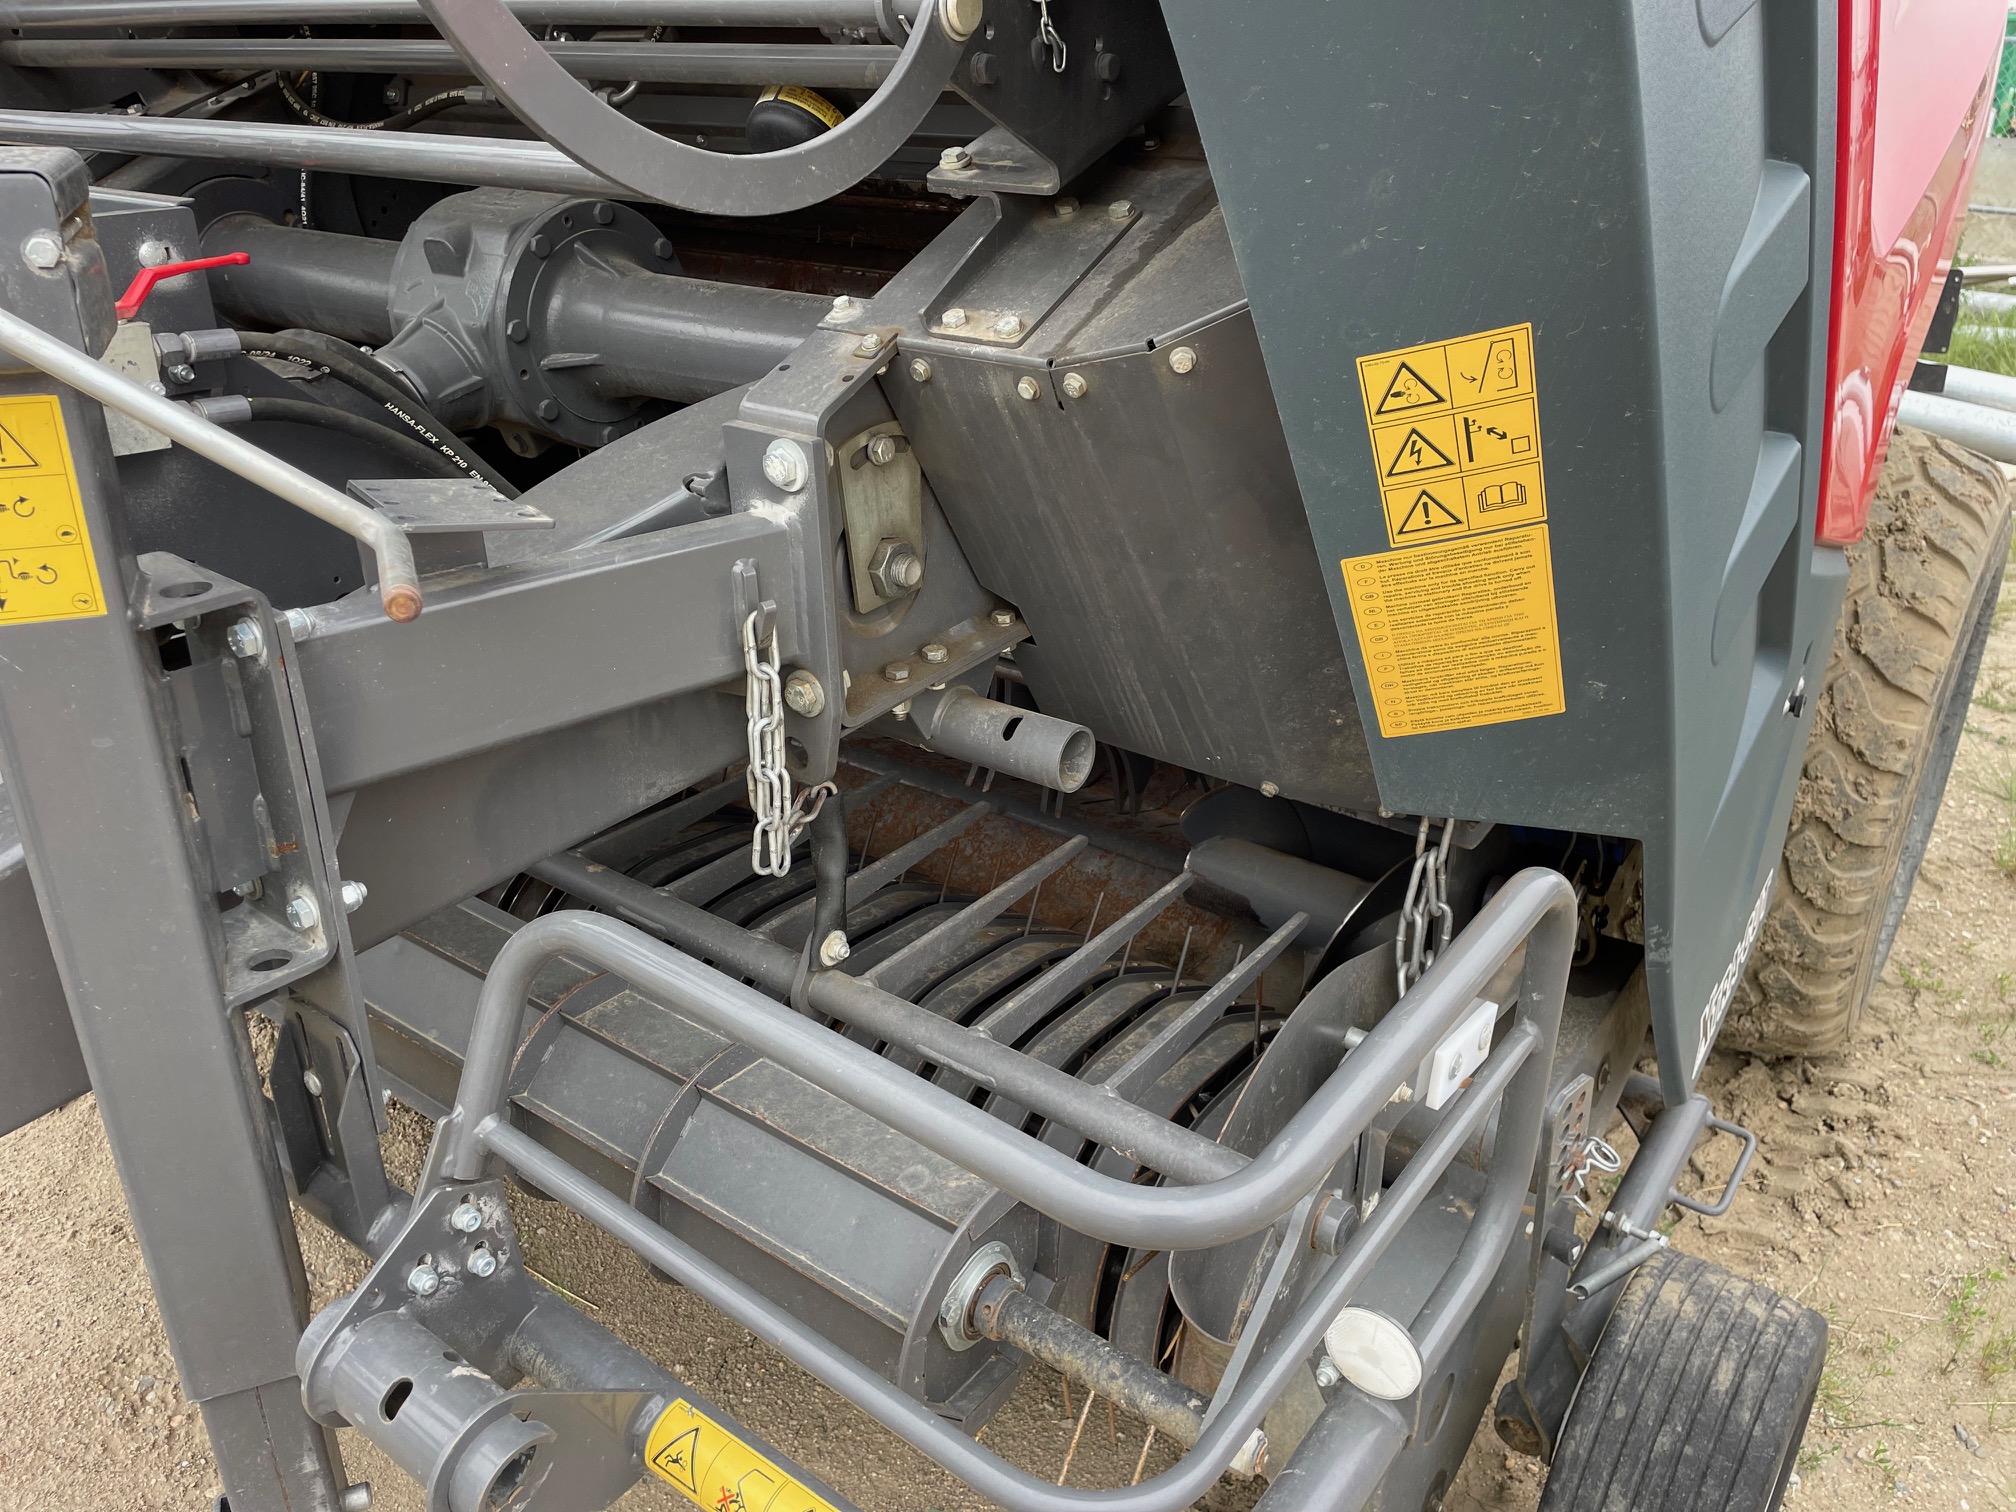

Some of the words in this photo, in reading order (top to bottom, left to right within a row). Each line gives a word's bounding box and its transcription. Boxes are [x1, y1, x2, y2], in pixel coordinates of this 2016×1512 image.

[384, 402, 440, 444] HANSA-FLEX
[440, 445, 455, 456] KP
[452, 456, 468, 469] 210
